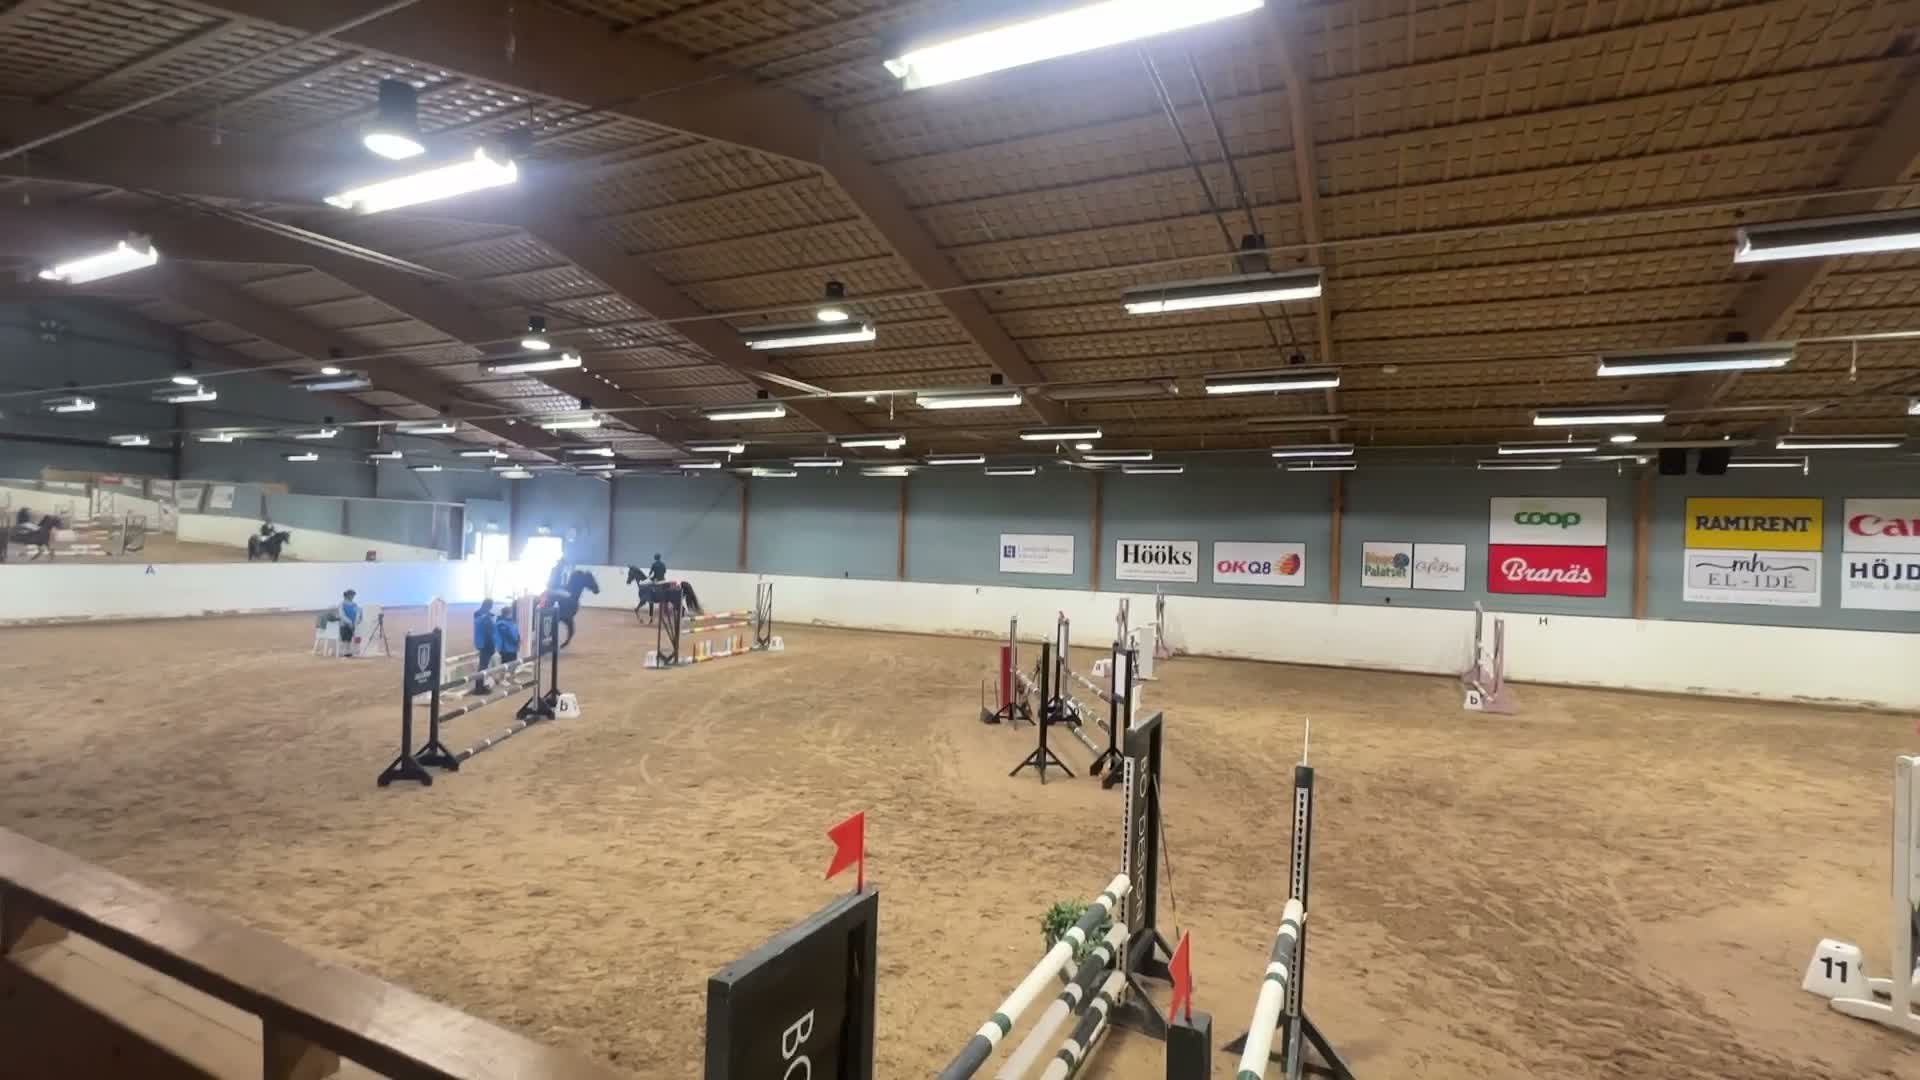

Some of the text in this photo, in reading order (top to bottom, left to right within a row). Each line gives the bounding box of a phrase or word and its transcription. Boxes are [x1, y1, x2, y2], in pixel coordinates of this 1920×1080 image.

[1514, 511, 1581, 529] coop
[1695, 515, 1813, 532] RAMIRENT
[1848, 513, 1920, 537] Ca
[1121, 543, 1192, 566] Hööks
[1217, 560, 1272, 575] OKQ8
[1501, 557, 1593, 583] Branäs
[559, 699, 568, 712] b
[1470, 695, 1478, 705] b
[1135, 815, 1146, 922] DESIGN
[1820, 956, 1848, 984] 11
